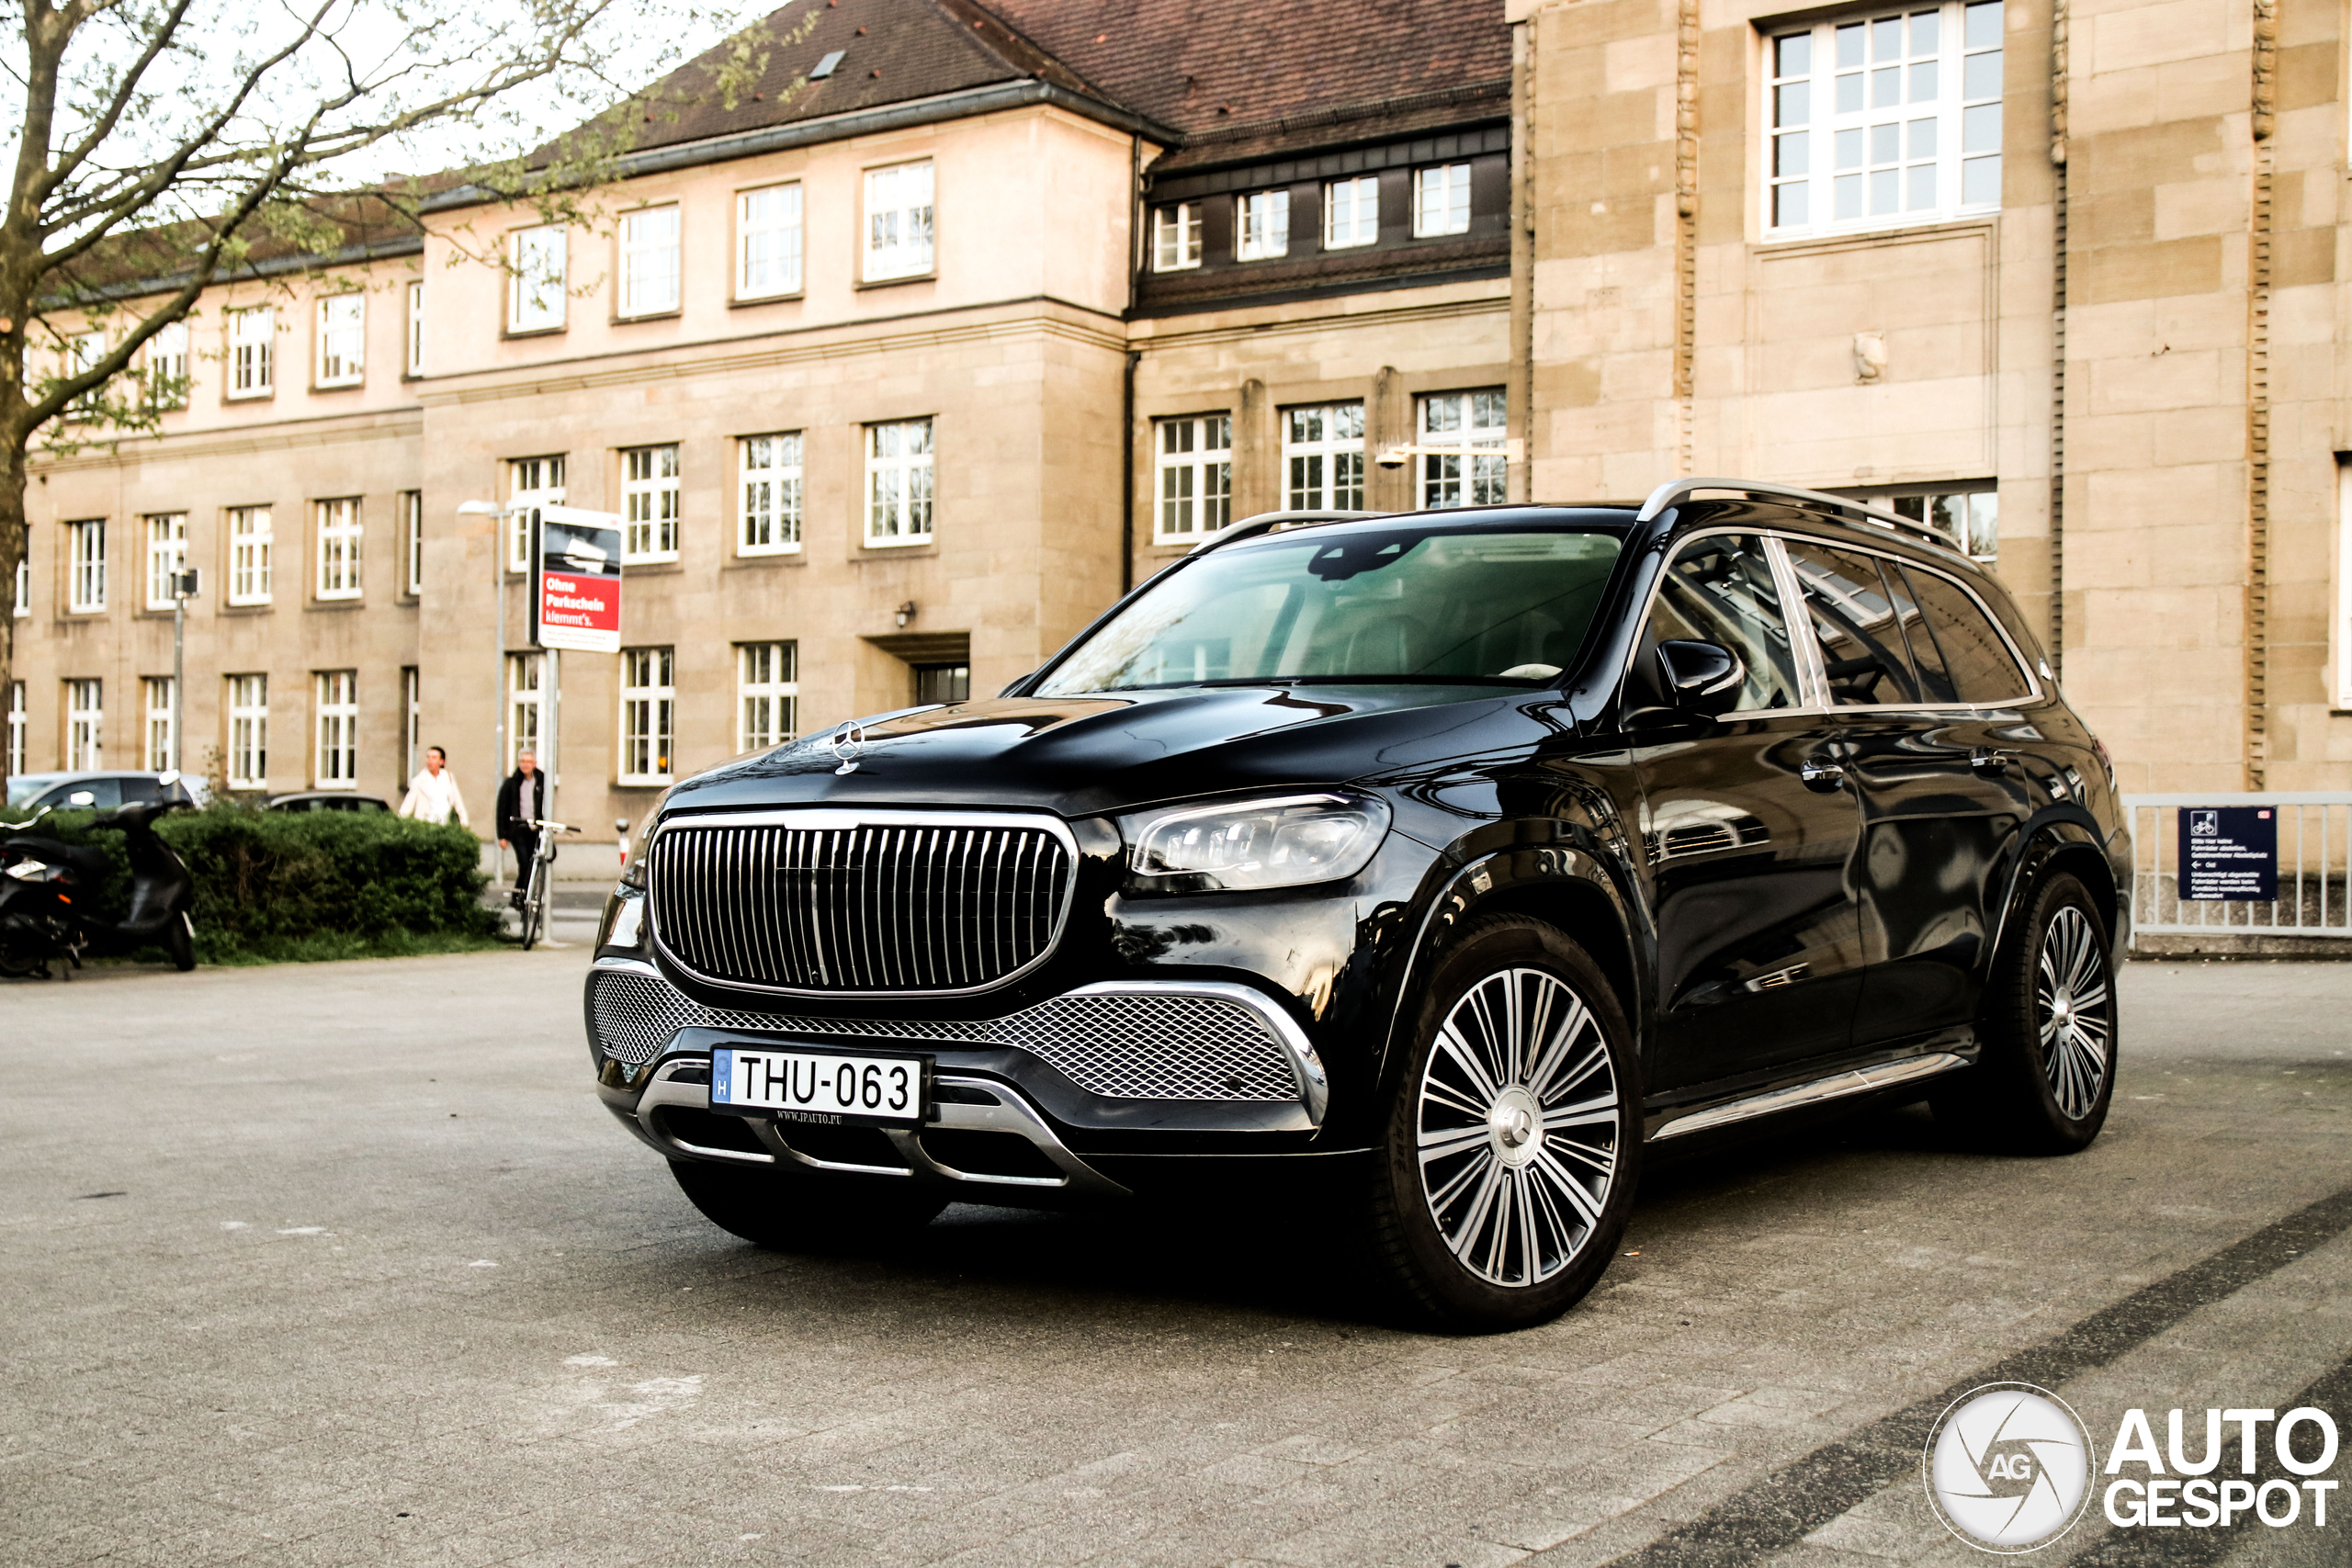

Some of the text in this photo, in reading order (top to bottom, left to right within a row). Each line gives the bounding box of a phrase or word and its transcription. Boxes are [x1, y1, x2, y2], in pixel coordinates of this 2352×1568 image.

[546, 577, 576, 593] Ohne
[546, 593, 605, 612] Parkschein
[717, 1080, 727, 1096] H
[740, 1056, 910, 1111] THU-063
